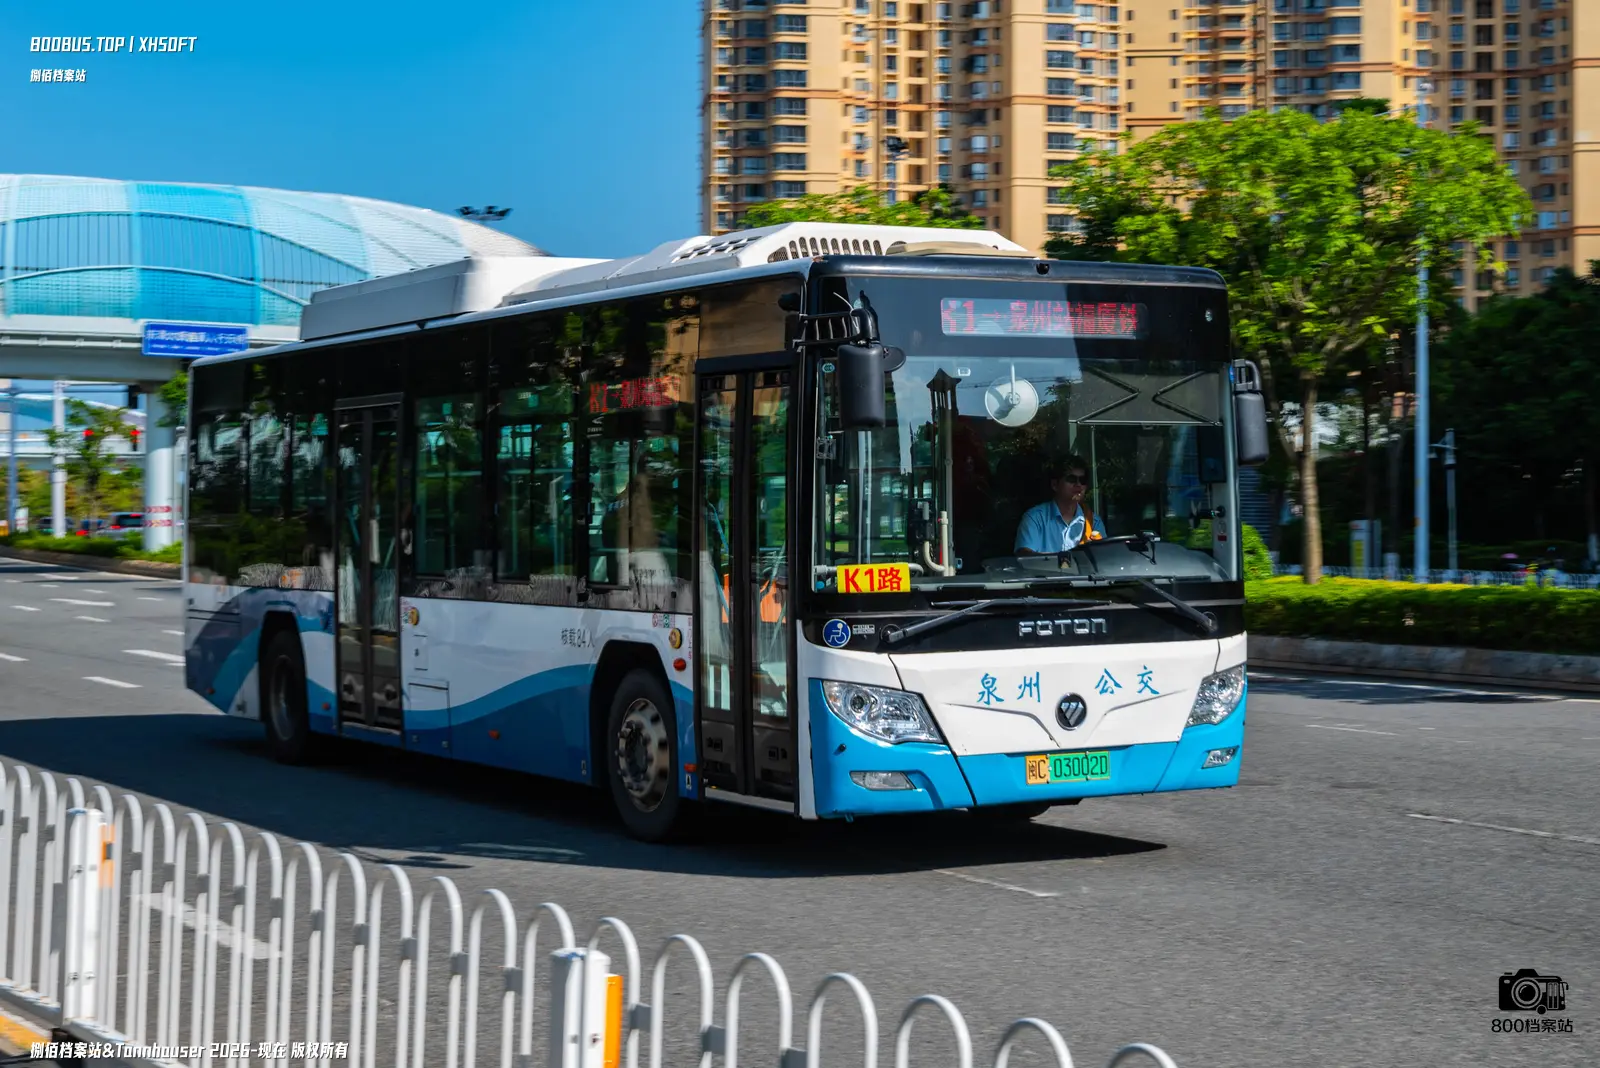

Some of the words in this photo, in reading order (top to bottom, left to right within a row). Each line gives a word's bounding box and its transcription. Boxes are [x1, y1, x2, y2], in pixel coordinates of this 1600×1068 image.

[844, 566, 903, 593] K1路
[1019, 618, 1107, 636] FOTON
[976, 671, 1042, 706] 泉州
[1094, 664, 1160, 696] 公交
